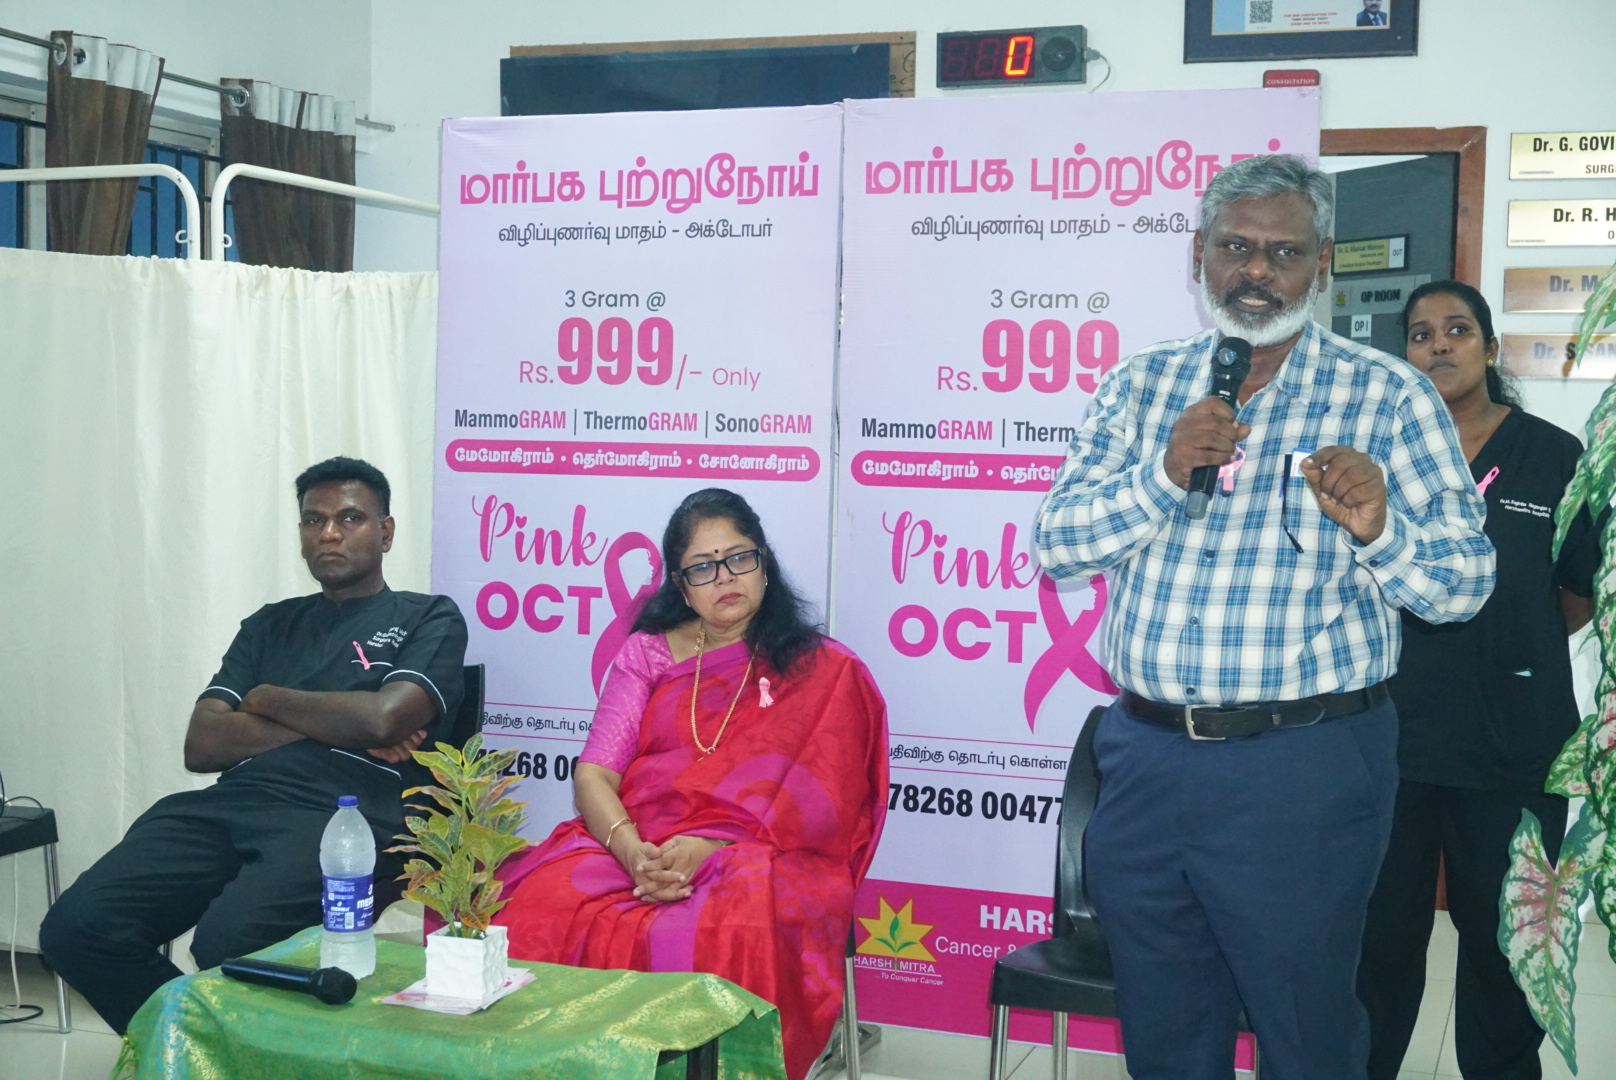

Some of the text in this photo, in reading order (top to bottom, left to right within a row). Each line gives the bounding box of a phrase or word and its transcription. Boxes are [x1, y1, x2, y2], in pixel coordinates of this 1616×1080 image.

[1533, 137, 1553, 152] Dr.
[1559, 136, 1573, 152] G.
[865, 145, 1014, 195] மார்பக
[460, 151, 819, 214] மார்பக புற்றுநோய்
[1553, 208, 1574, 222] Dr.
[1582, 207, 1598, 222] R.
[498, 221, 610, 247] விழிப்புணர்வு
[616, 220, 666, 244] மாதம்
[685, 218, 773, 239] அக்டோபர்
[911, 214, 1044, 242] விழிப்புணர்வு
[1050, 213, 1110, 240] மாதம்
[1392, 248, 1403, 257] OUT
[1550, 275, 1574, 292] Dr.
[565, 290, 666, 312] 3 Gram @
[990, 289, 1110, 314] 3 Gram @
[1361, 289, 1401, 303] OP ROOM
[1354, 320, 1365, 332] OP
[1534, 342, 1558, 360] Dr.
[712, 367, 761, 392] Only
[454, 409, 812, 434] MammoGRAM ThermoGRAM SonoGRAM
[861, 418, 1077, 443] MammoGRAM Therm
[455, 446, 810, 474] மேமோகிராம் தெர்மோகிராம் சோனோகிராம்
[862, 459, 979, 481] மேமோகிராம்
[472, 494, 608, 567] Pink
[882, 511, 1041, 590] Pink
[526, 716, 576, 735] தொடர்பு
[948, 750, 1006, 770] தொடர்பு
[888, 783, 973, 817] 78268
[935, 936, 1001, 959] Cancer
[890, 973, 918, 983] Conquer
[920, 977, 944, 986] Cancer
